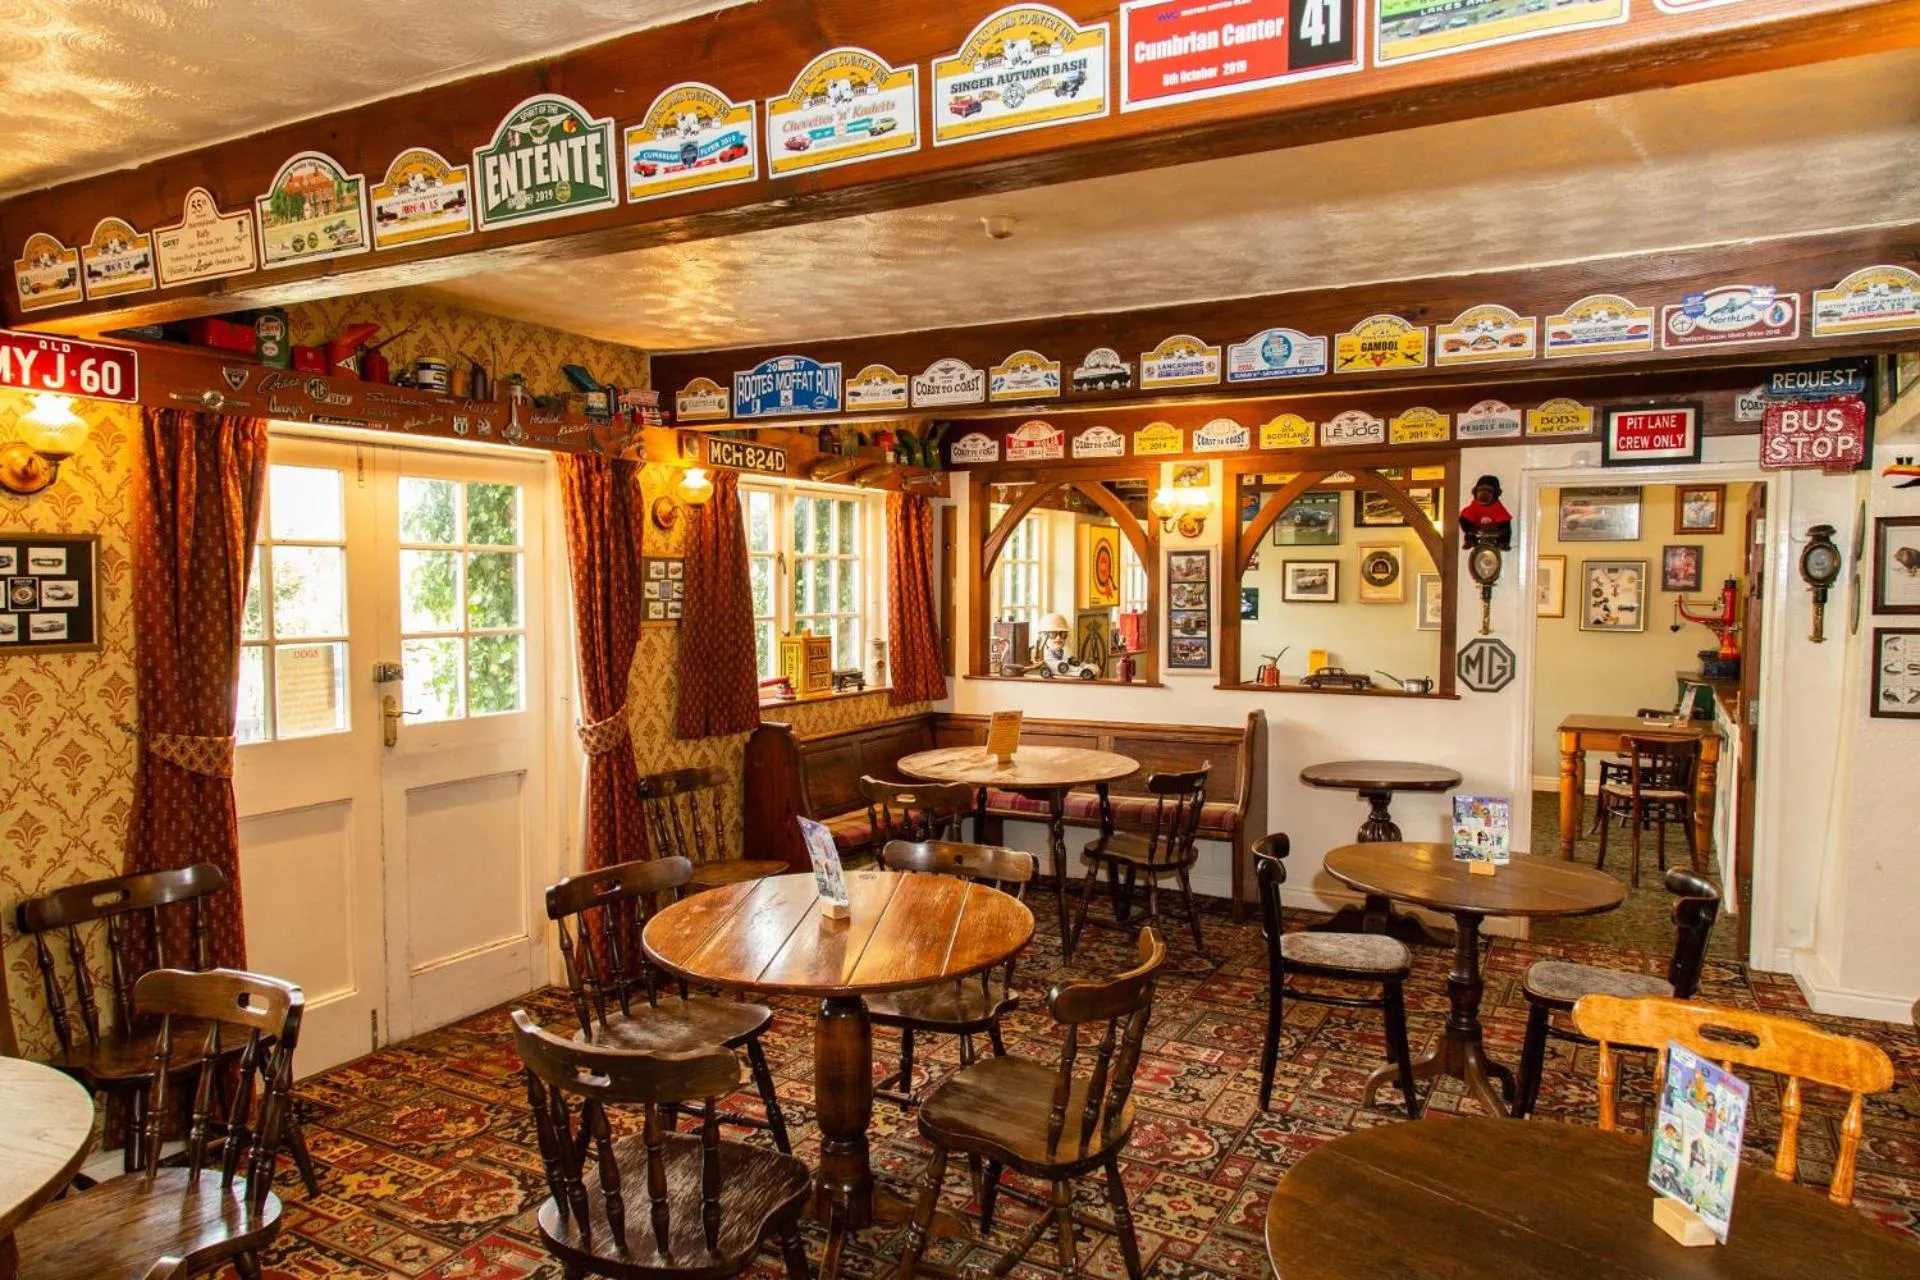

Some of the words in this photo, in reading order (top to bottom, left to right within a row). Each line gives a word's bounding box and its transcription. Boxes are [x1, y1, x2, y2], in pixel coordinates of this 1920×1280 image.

[1301, 0, 1341, 47] 41
[1134, 29, 1219, 63] Cumbrian
[1222, 17, 1285, 47] Canter
[950, 77, 994, 94] SINGER
[996, 66, 1050, 86] AUTUMN
[1052, 58, 1087, 74] BASH
[1180, 66, 1218, 84] October
[1222, 60, 1248, 76] 2019
[782, 114, 834, 133] Chevettes
[852, 100, 897, 119] Kadetts
[643, 151, 680, 161] CUMBRIAN
[485, 132, 605, 212] ENTENTE
[535, 190, 554, 203] 2019
[309, 379, 327, 400] MG
[737, 374, 773, 407] ROOTES
[775, 369, 813, 391] MOFFAT
[816, 368, 838, 400] RUN
[915, 381, 940, 396] COAST
[942, 385, 953, 394] TO
[954, 375, 980, 393] COAST
[1772, 368, 1858, 390] REQUEST
[1326, 427, 1342, 438] LE
[1627, 416, 1643, 430] PIT
[1648, 415, 1677, 429] LANE
[1781, 409, 1844, 433] BUS
[1150, 442, 1167, 450] 2014
[1619, 436, 1650, 449] CREW
[1653, 434, 1685, 447] ONLY
[1770, 435, 1855, 460] STOP
[710, 441, 743, 466] MCH
[745, 447, 785, 471] 824D
[1464, 645, 1508, 686] MG
